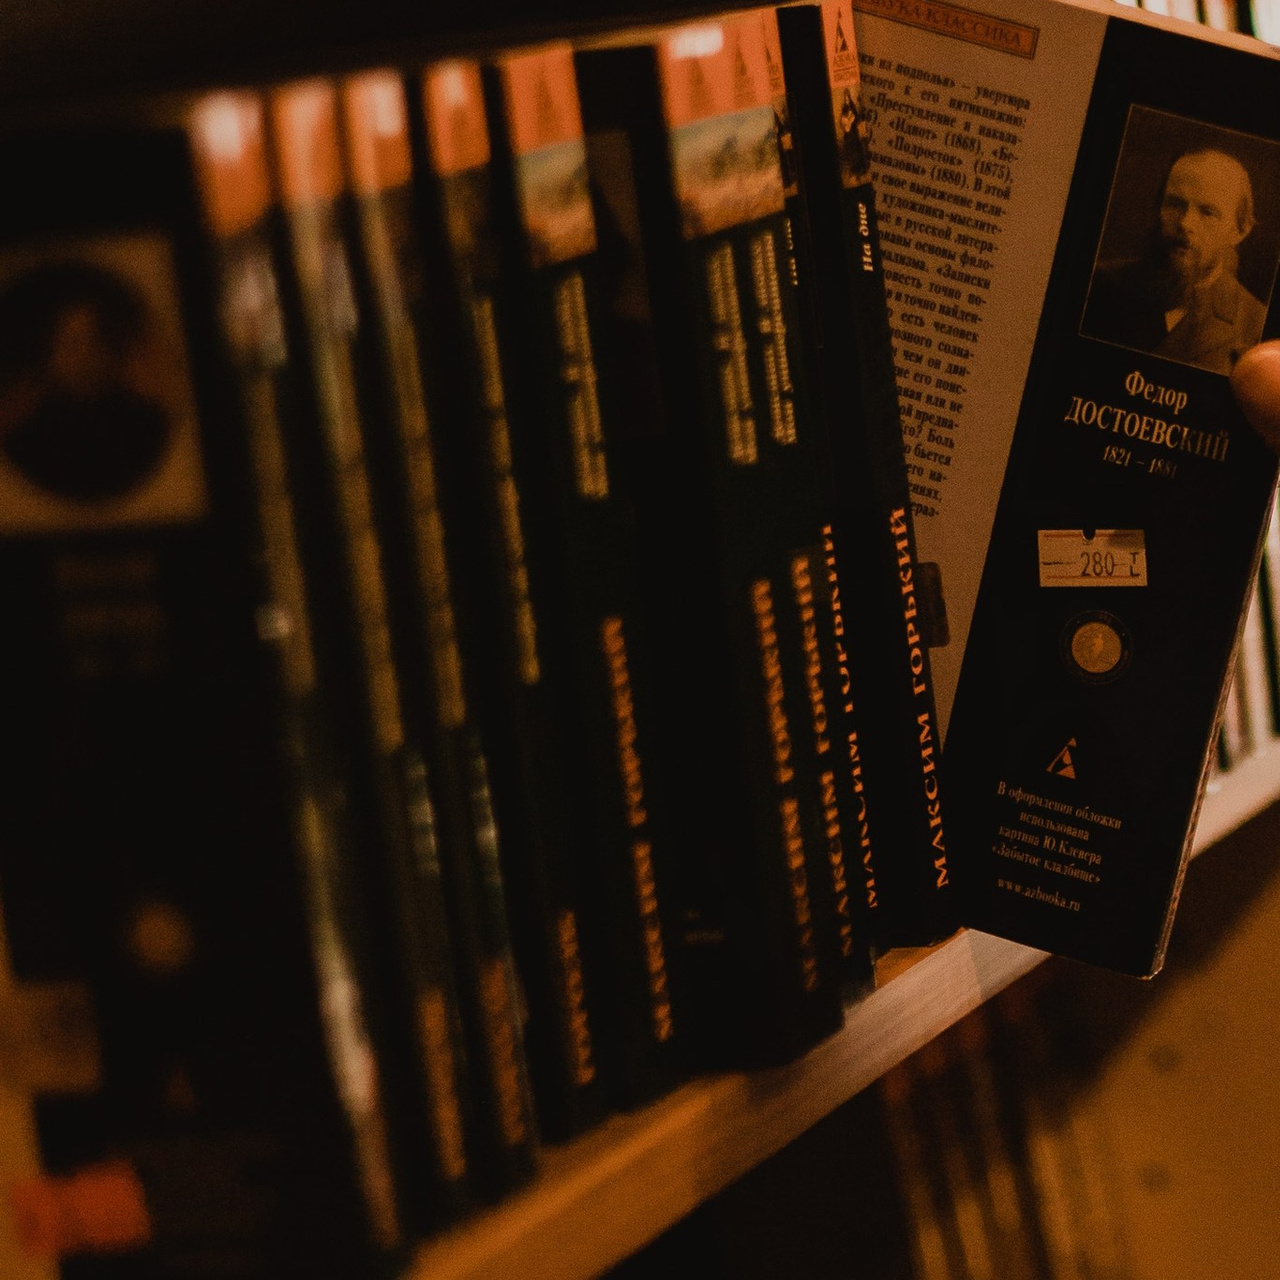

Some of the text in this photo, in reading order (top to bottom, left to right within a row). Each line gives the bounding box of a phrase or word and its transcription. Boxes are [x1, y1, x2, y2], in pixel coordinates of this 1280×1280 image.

[920, 90, 940, 103] его
[976, 86, 1031, 111] увертюра
[973, 178, 983, 191] В
[904, 218, 952, 241] русской
[885, 270, 923, 289] овесть
[928, 282, 961, 299] точно
[904, 294, 936, 311] точно
[900, 312, 925, 327] есть
[933, 321, 979, 342] человек
[912, 371, 932, 385] его
[1125, 370, 1189, 416] Федор
[926, 429, 955, 448] Боль
[1064, 395, 1230, 462] ДОСТОЕВСКИЙ
[1102, 444, 1133, 468] 1821
[1080, 551, 1115, 577] 280
[890, 506, 950, 890] МАКСИМ ГОРЬКИЙ
[997, 781, 1122, 830] В оформлении обложки
[1020, 811, 1090, 841] использована
[998, 825, 1040, 847] картина
[1059, 839, 1102, 866] Клевера
[996, 878, 1081, 912] www.azbooka.ru
